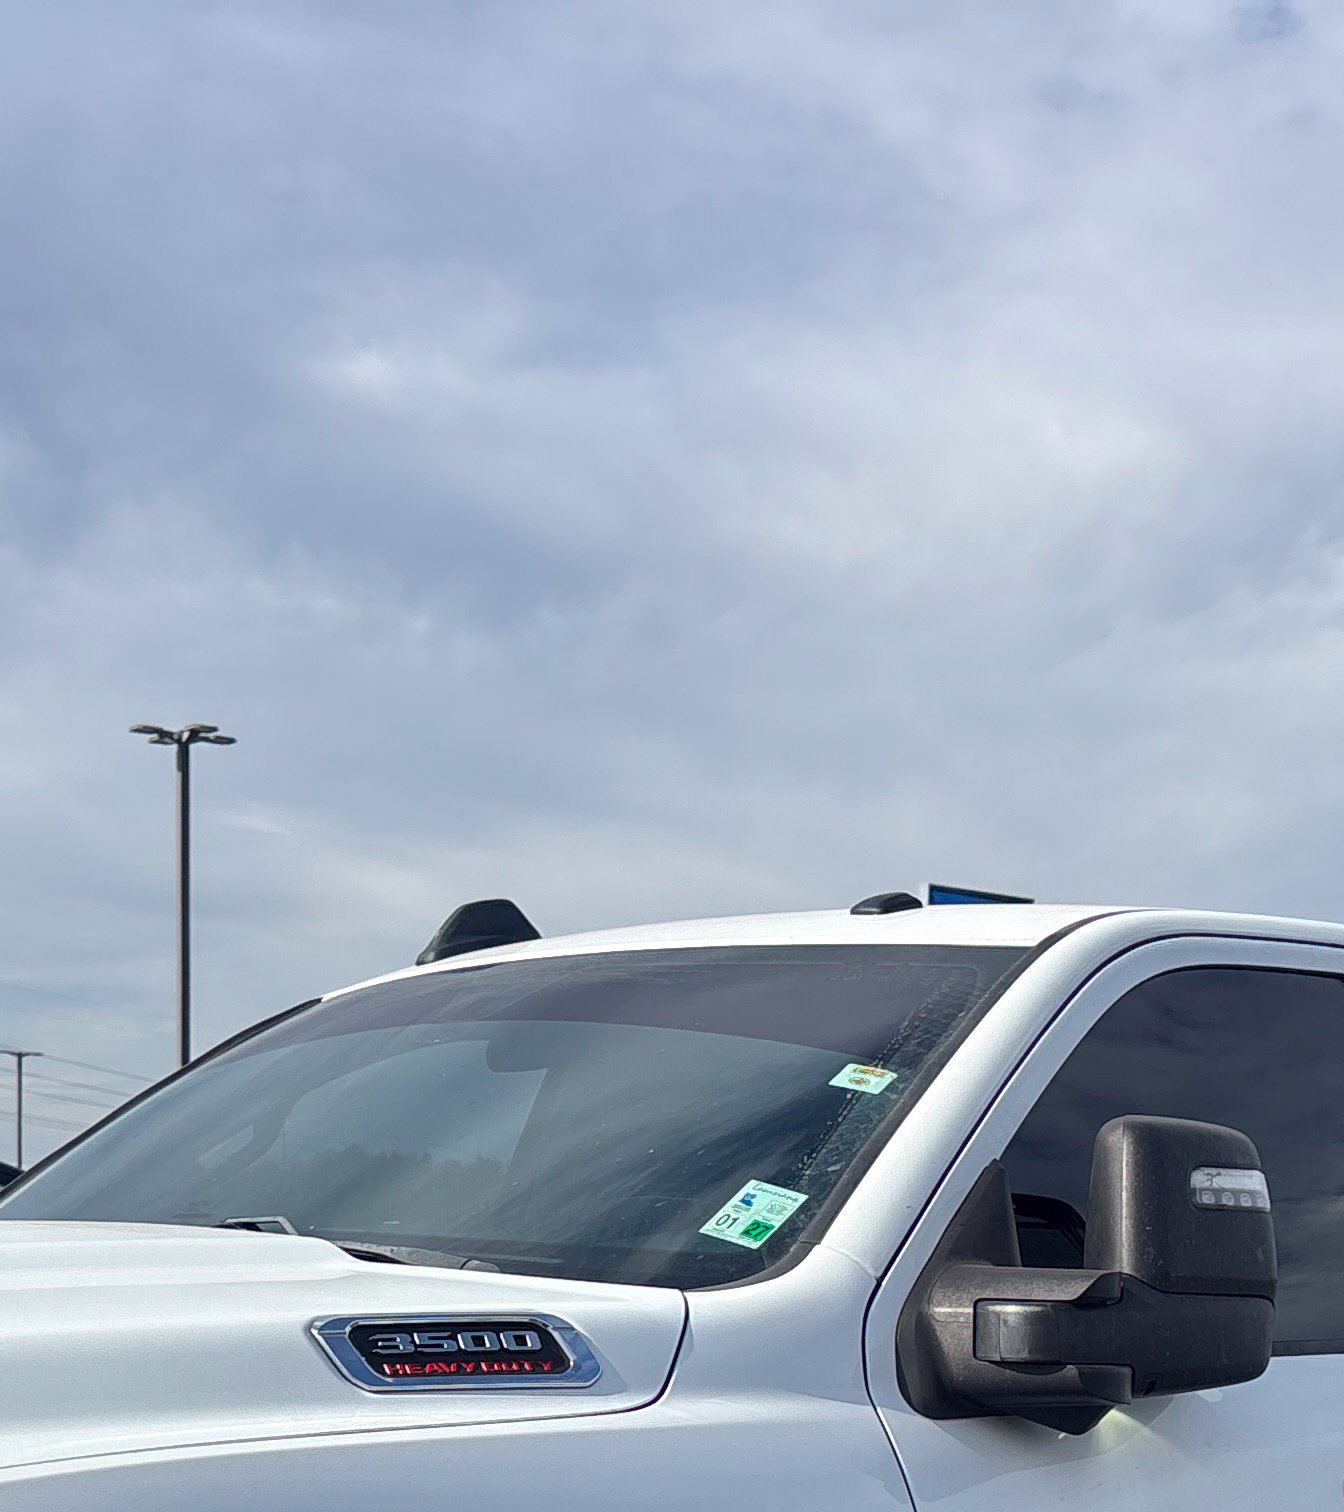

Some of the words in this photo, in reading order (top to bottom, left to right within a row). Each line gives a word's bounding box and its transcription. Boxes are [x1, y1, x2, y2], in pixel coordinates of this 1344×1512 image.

[715, 1213, 740, 1229] 01
[745, 1222, 769, 1238] 27
[368, 1330, 543, 1354] 3500
[382, 1362, 476, 1376] HEAVY
[480, 1360, 554, 1373] DUTY
